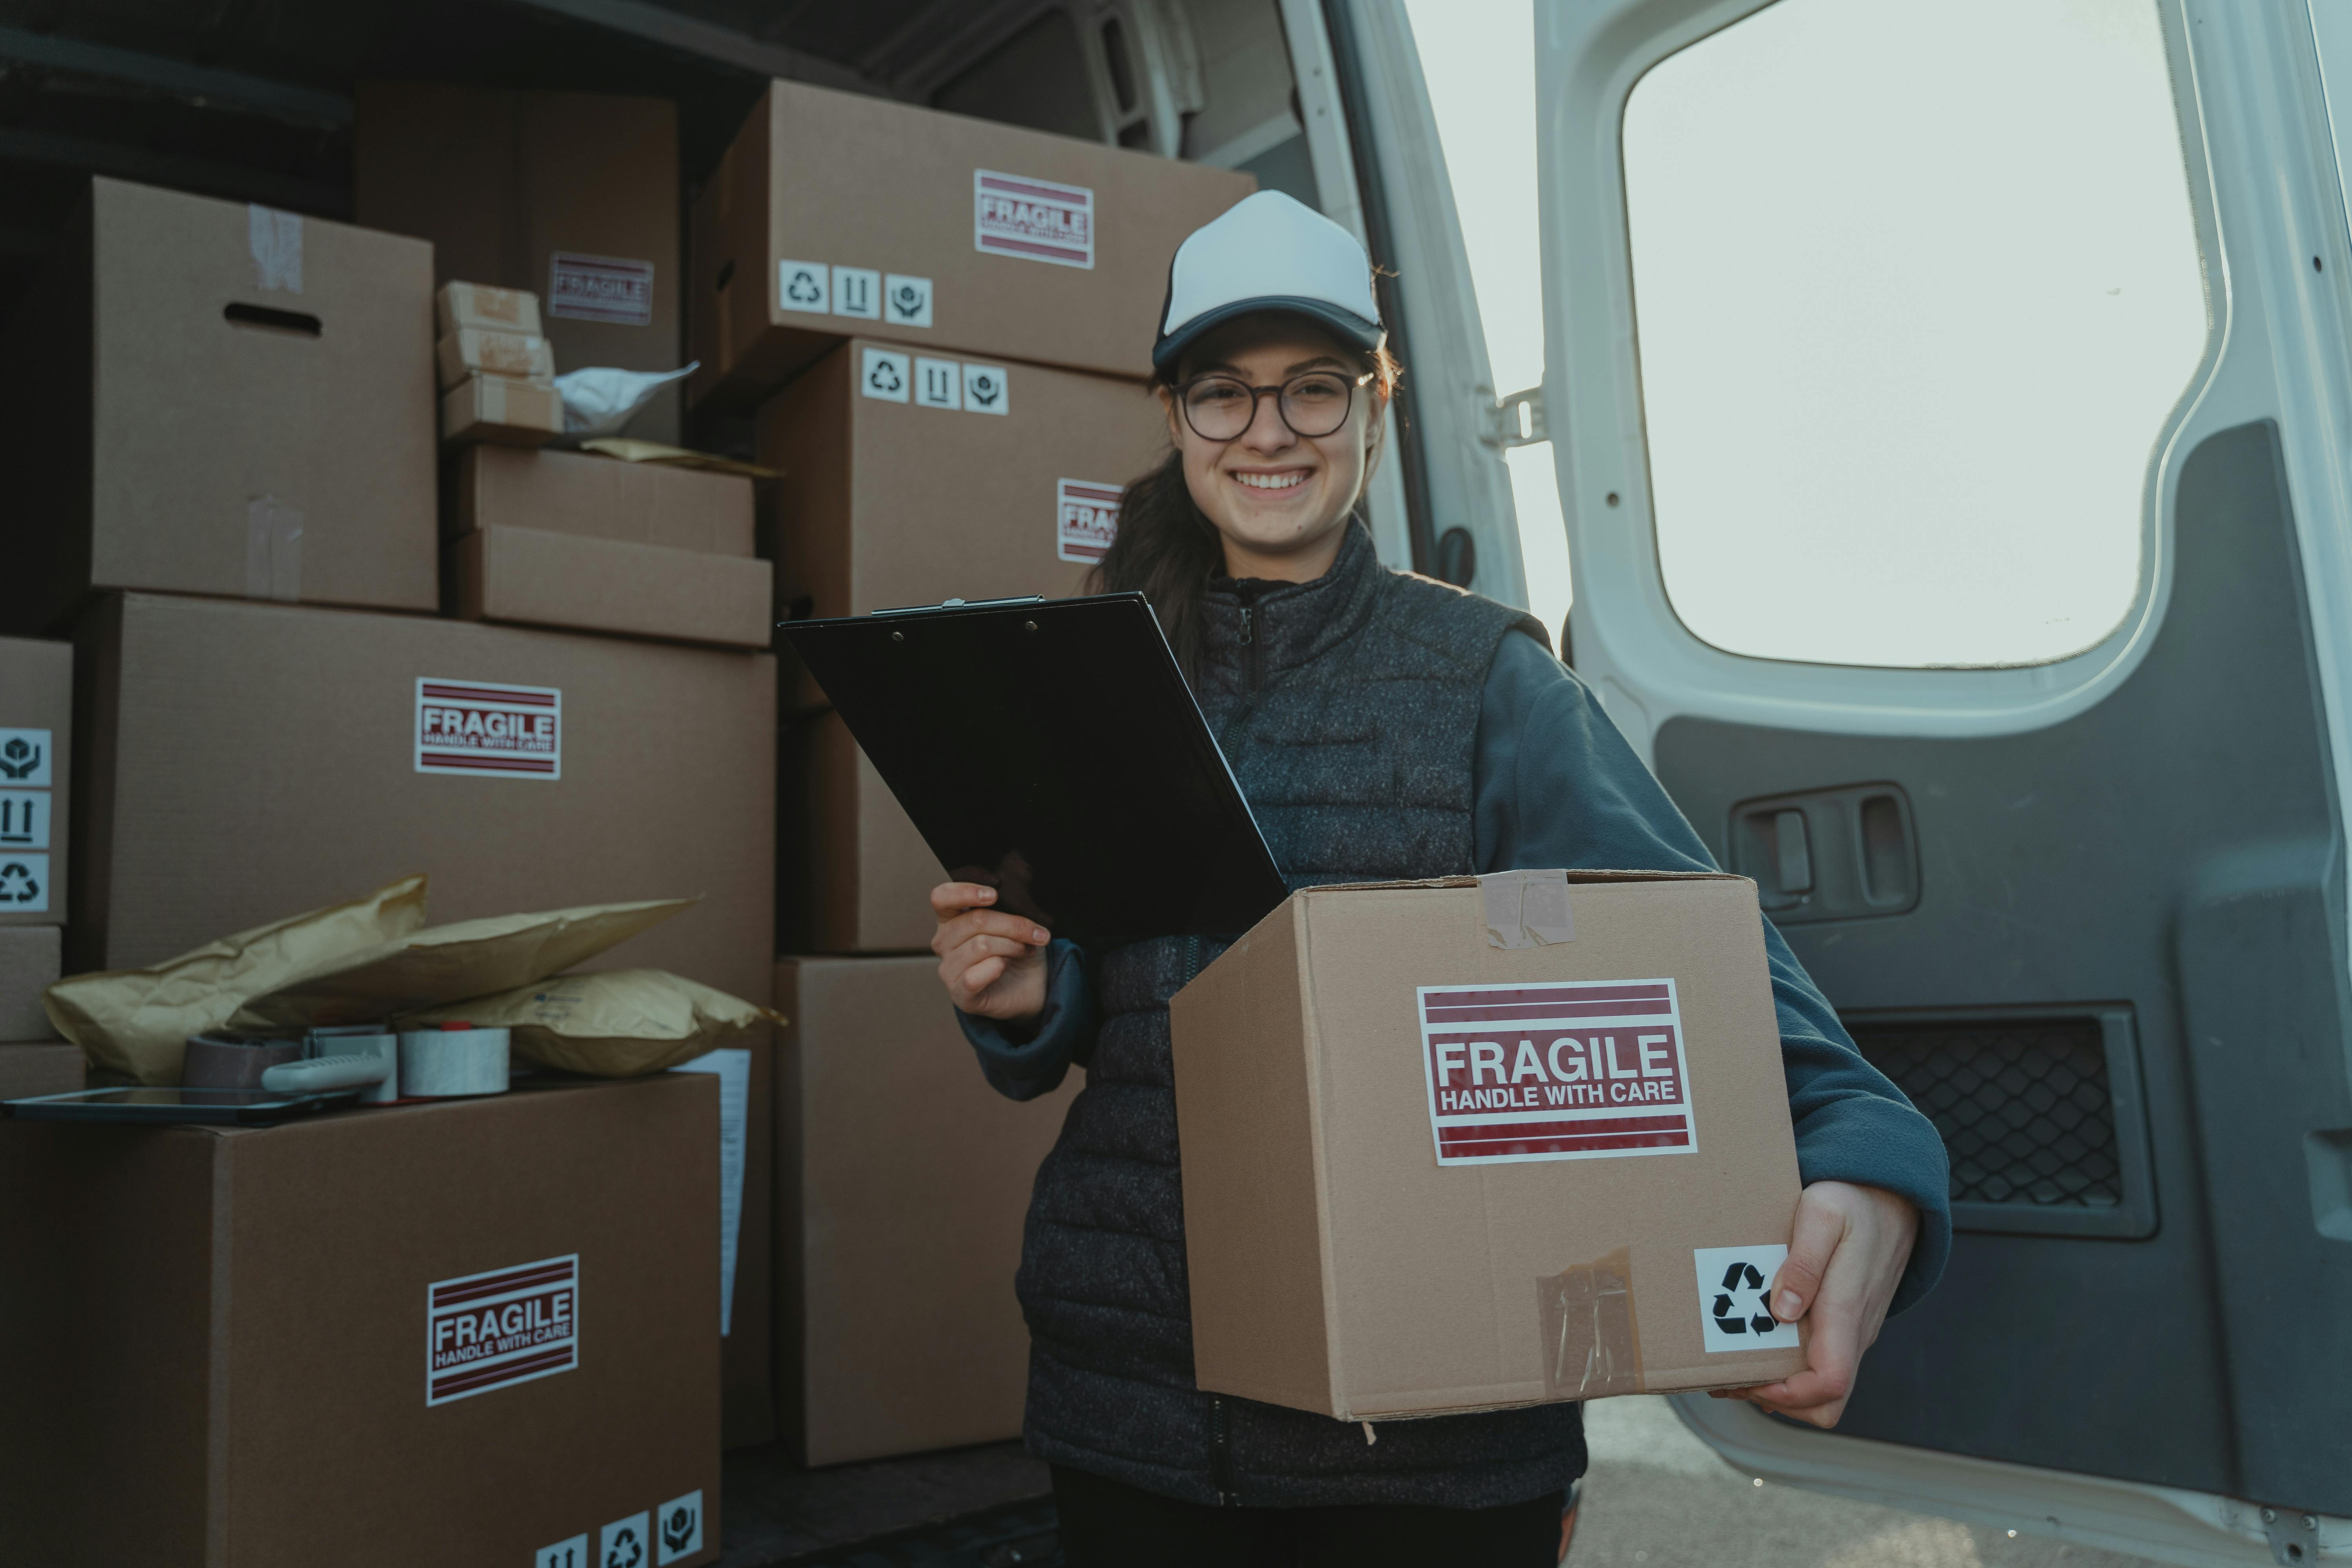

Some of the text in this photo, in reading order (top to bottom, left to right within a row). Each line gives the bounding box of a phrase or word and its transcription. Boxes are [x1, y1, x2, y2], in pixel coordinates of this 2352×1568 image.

[982, 197, 1085, 234] FRAGILE
[424, 707, 554, 740] FRAGILE
[482, 736, 515, 749] WITH
[1435, 1034, 1673, 1087] FRAGILE
[1441, 1080, 1676, 1111] HANDLE WITH CARE
[436, 1292, 571, 1352] FRAGILE
[436, 1322, 571, 1368] HANDLE WITH CARE
